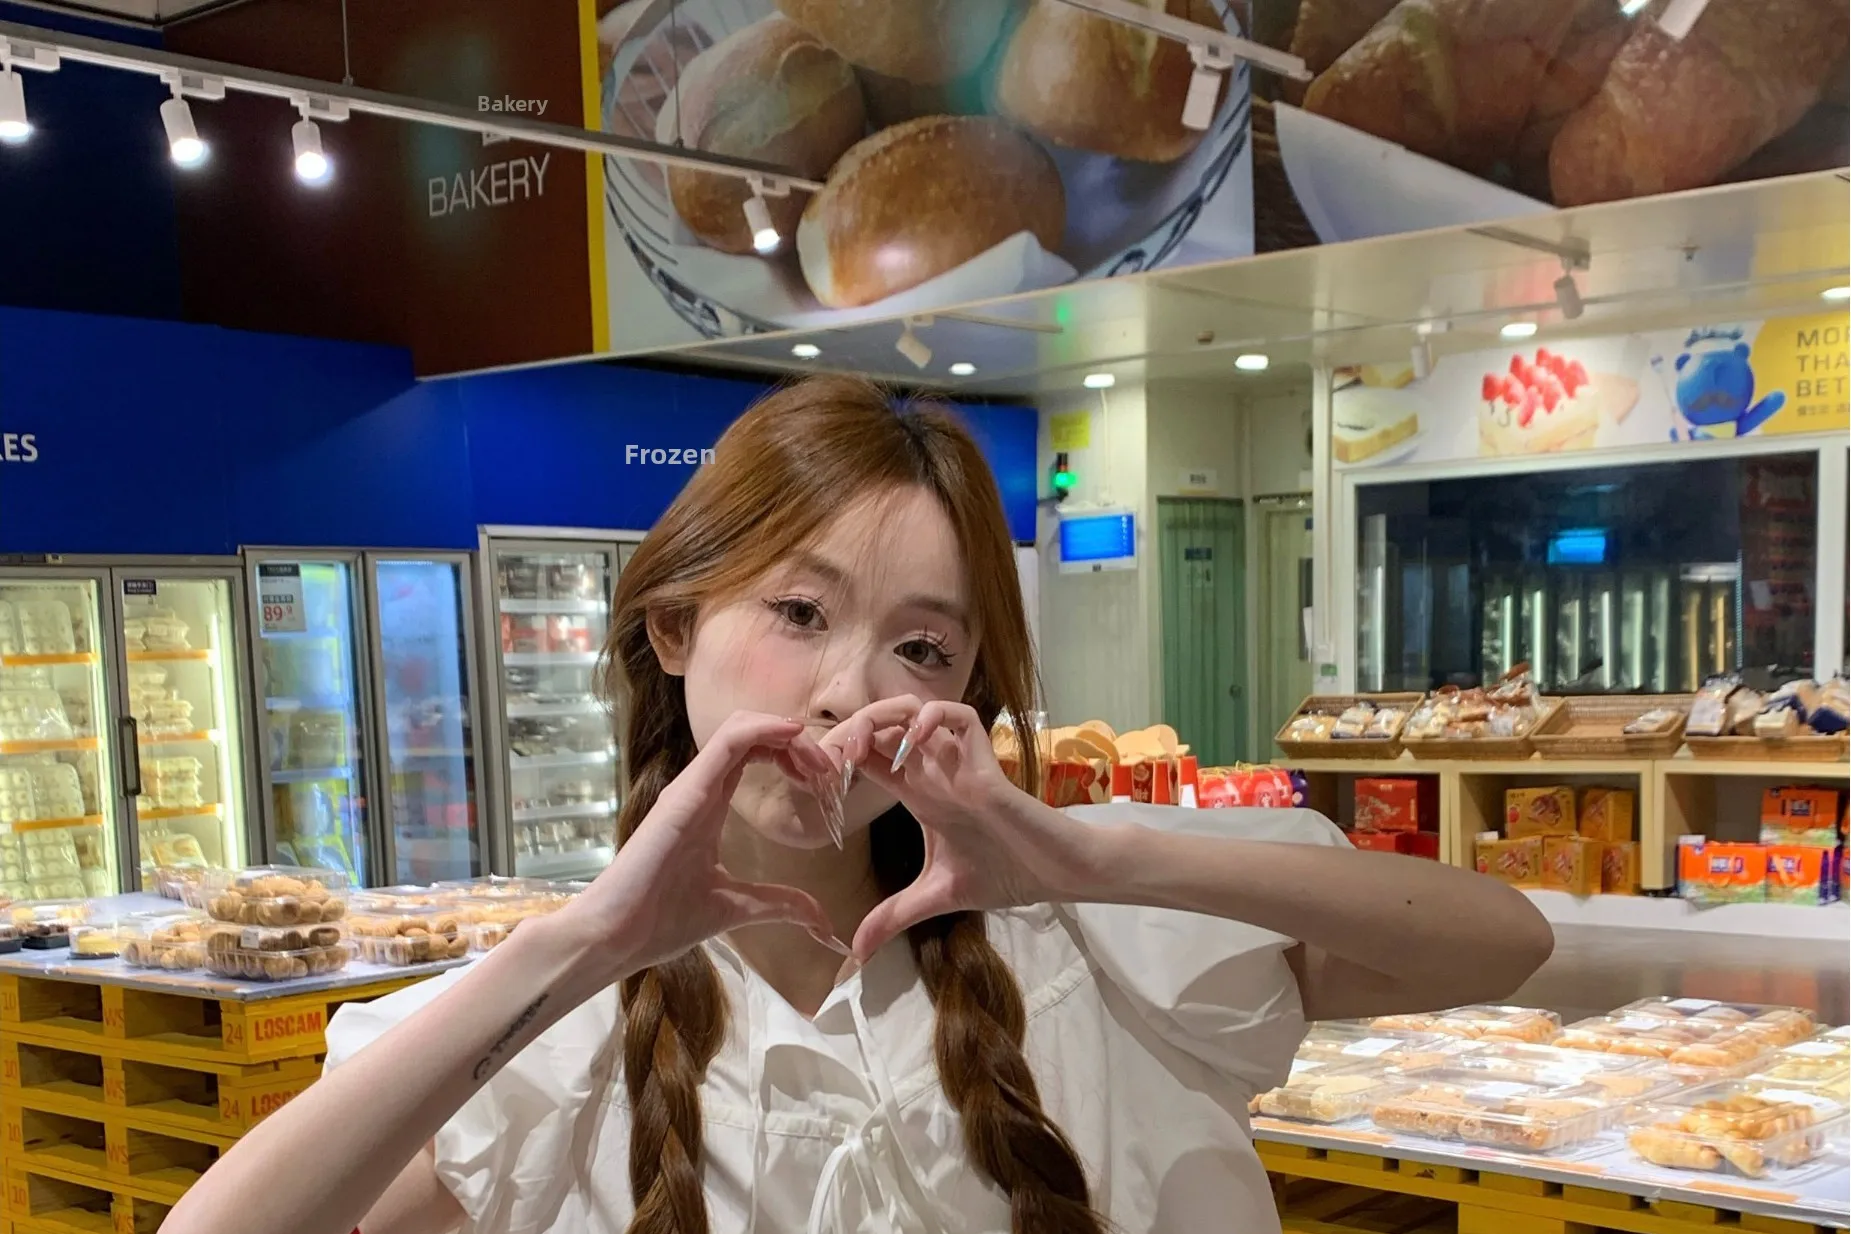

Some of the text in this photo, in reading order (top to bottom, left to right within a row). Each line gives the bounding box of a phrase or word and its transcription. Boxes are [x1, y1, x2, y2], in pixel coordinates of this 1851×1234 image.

[428, 151, 551, 218] BAKERY
[0, 432, 38, 462] ES
[224, 1022, 244, 1045] 24
[254, 1011, 322, 1042] LOSCAM
[221, 1096, 240, 1119] 24
